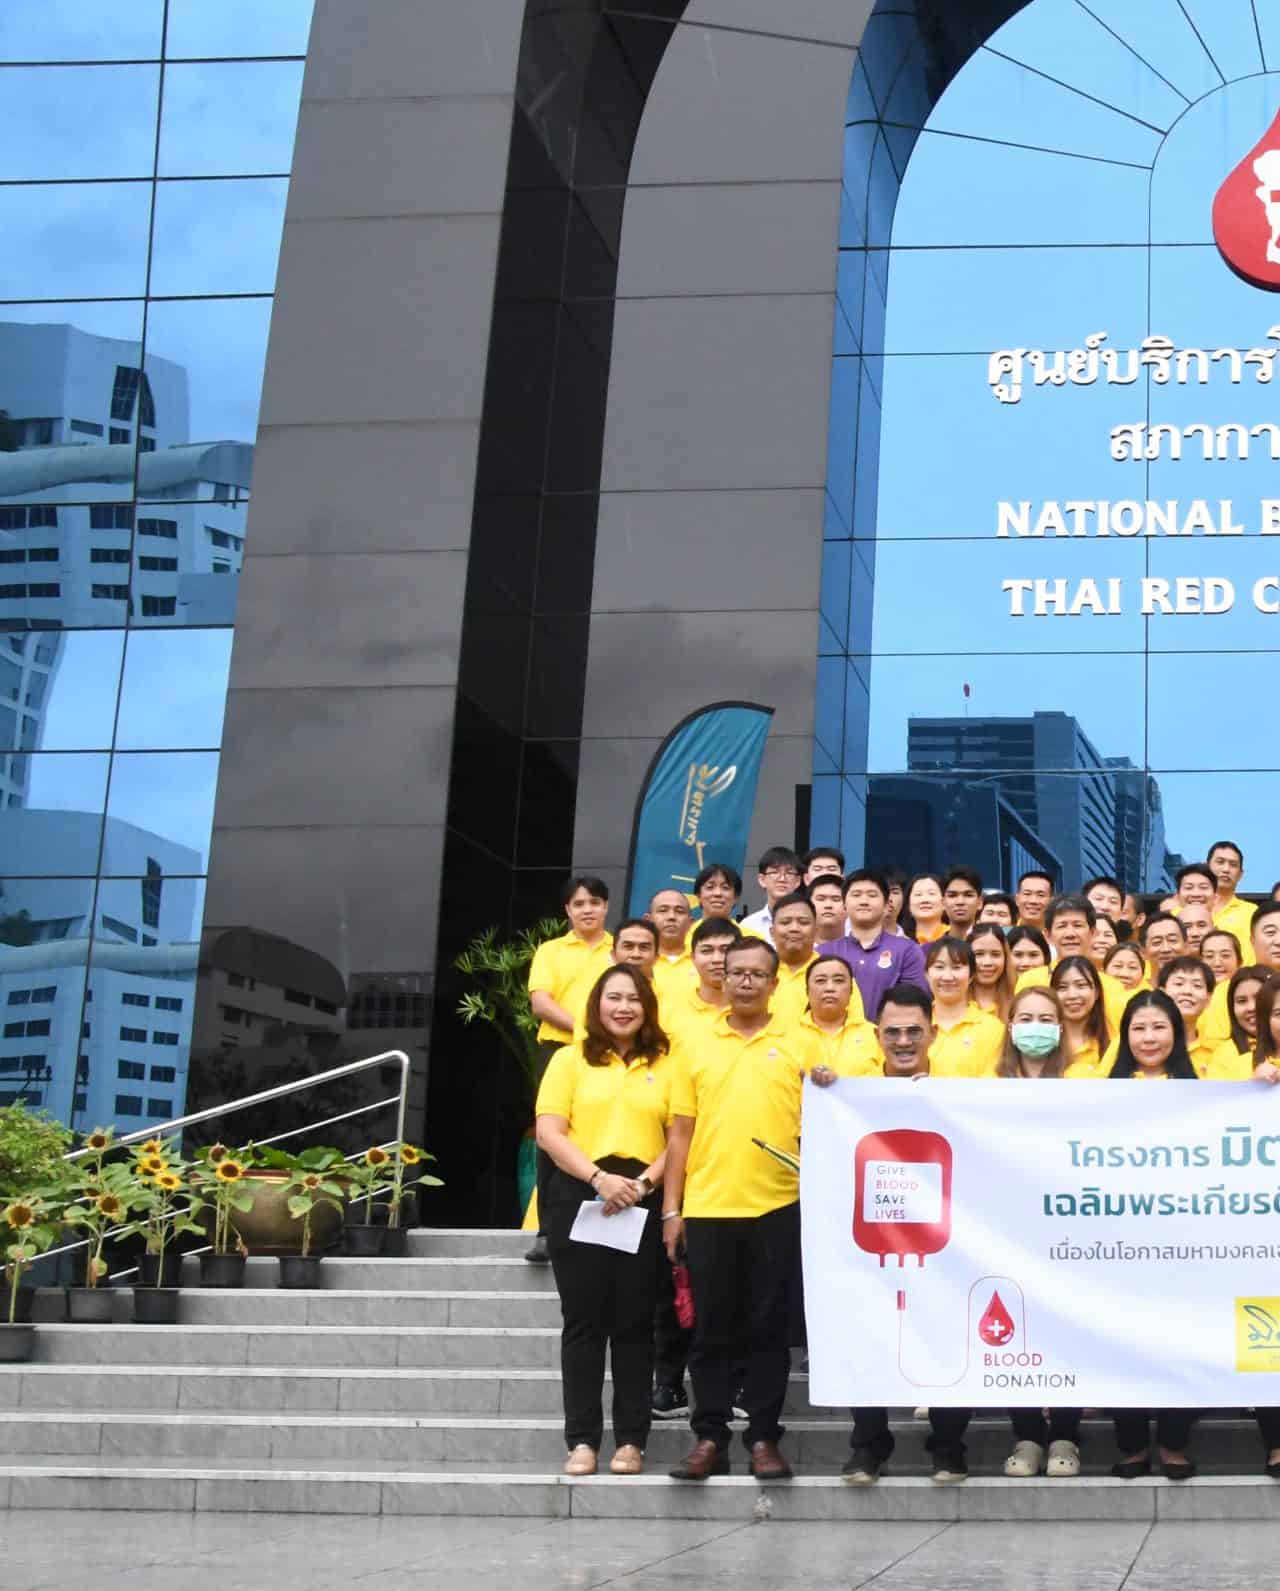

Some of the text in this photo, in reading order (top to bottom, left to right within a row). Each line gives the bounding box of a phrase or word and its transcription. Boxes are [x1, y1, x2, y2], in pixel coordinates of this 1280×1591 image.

[996, 499, 1244, 538] NATIONAL
[1002, 577, 1121, 616] THAI
[1139, 577, 1235, 615] RED
[1067, 1140, 1211, 1168] โครงการ
[876, 1165, 905, 1176] GIVE
[876, 1179, 919, 1191] BLOOD
[875, 1194, 905, 1205] SAVE
[875, 1208, 905, 1220] LIVES
[984, 1353, 1042, 1366] BLOOD
[983, 1374, 1075, 1388] DONATION
